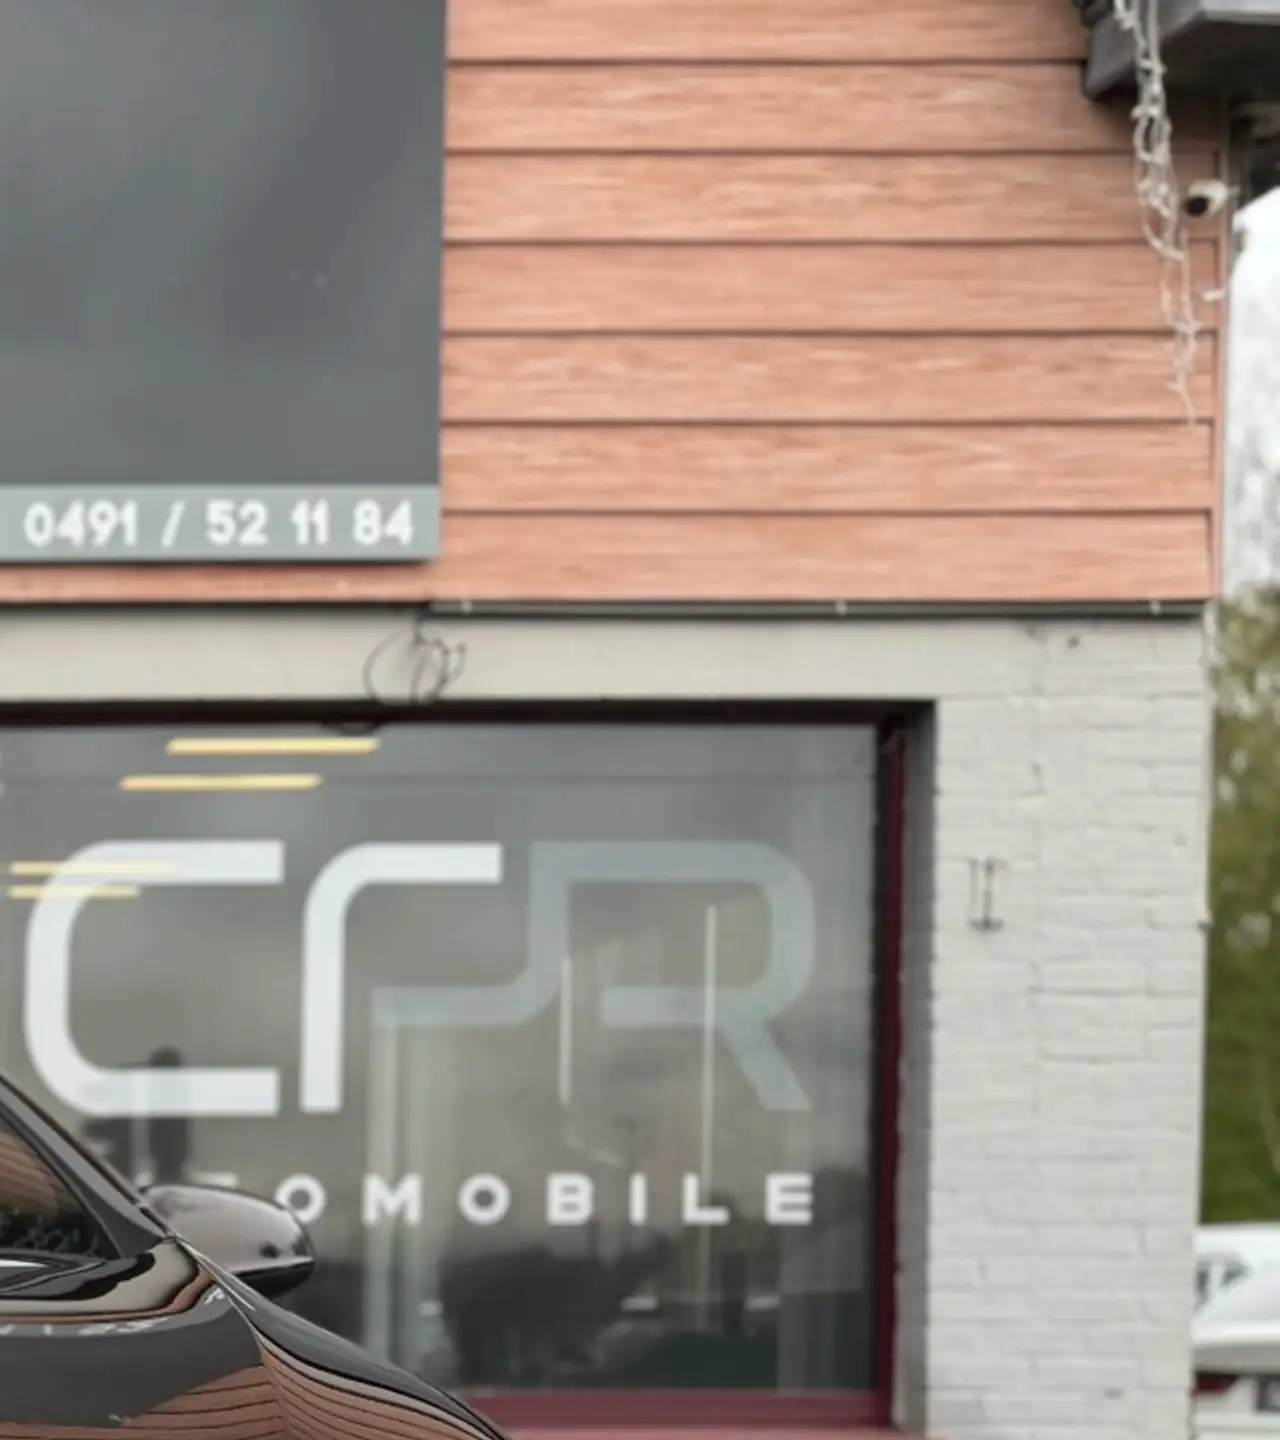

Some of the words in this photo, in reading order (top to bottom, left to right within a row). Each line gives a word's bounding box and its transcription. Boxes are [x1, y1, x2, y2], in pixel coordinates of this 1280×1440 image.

[22, 499, 139, 548] 0491
[160, 500, 187, 548] /
[205, 498, 270, 547] 52
[289, 499, 330, 547] 11
[351, 498, 416, 547] 84
[23, 839, 816, 1116] CPR
